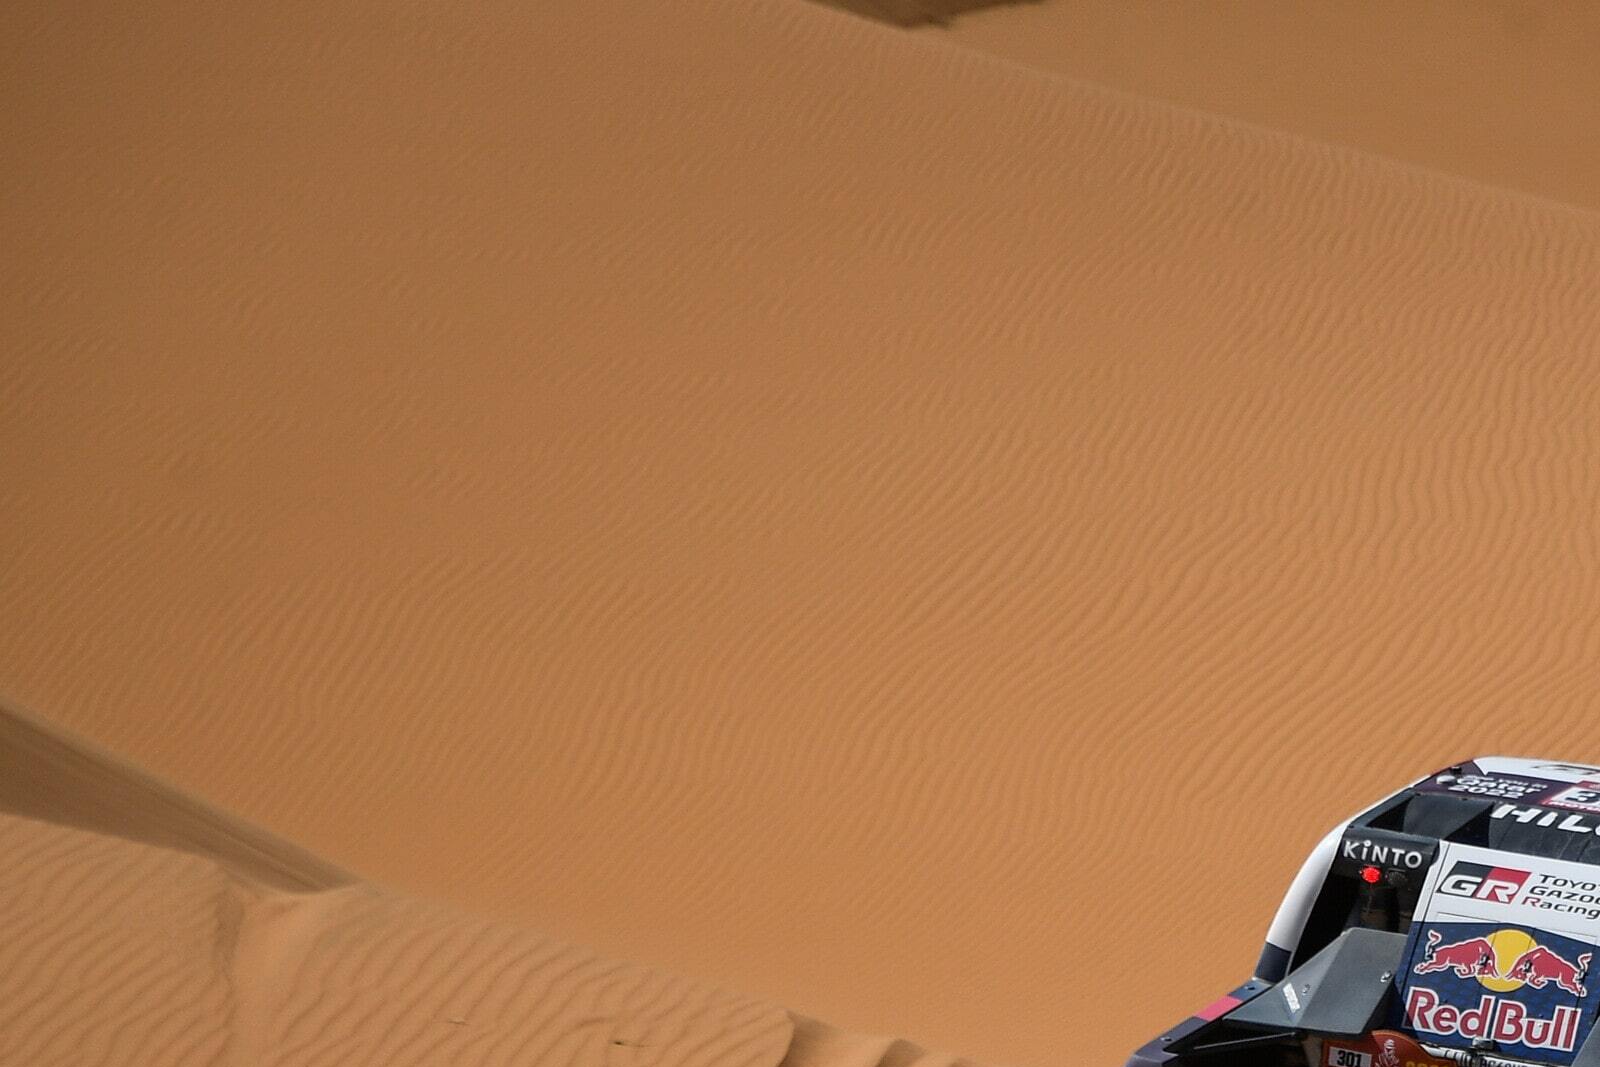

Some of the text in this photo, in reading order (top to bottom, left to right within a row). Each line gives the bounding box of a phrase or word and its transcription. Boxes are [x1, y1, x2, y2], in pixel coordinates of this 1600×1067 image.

[1447, 784, 1524, 799] 2022
[1439, 874, 1519, 904] GR
[1402, 986, 1582, 1052] Red Bull
